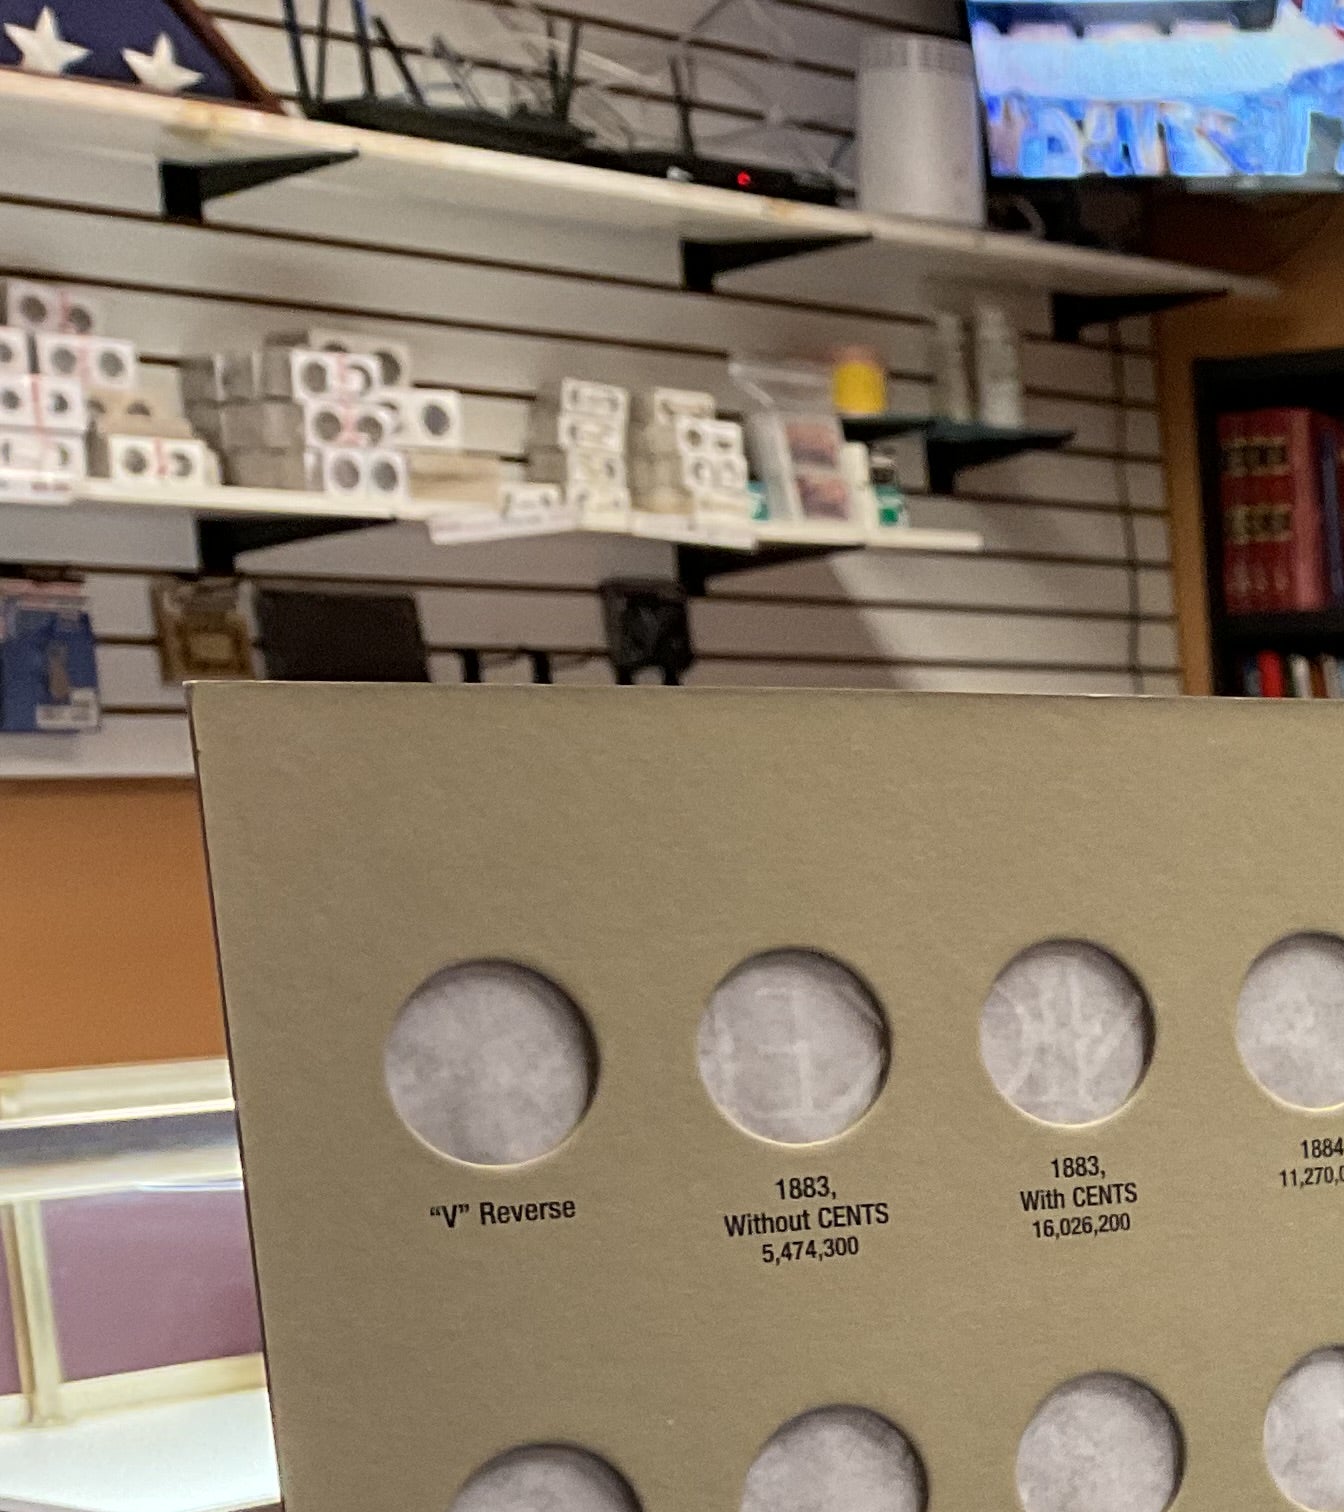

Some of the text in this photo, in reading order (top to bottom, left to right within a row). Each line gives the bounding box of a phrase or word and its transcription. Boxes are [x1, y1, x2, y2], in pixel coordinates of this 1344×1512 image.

[1299, 1138, 1344, 1159] 1884
[1050, 1155, 1106, 1179] 1883,
[774, 1176, 837, 1202] 1883,
[1018, 1182, 1138, 1212] With CENTS
[724, 1202, 890, 1238] Without CENTS
[1031, 1212, 1131, 1240] 16,026,200
[761, 1236, 860, 1265] 5,474,300
